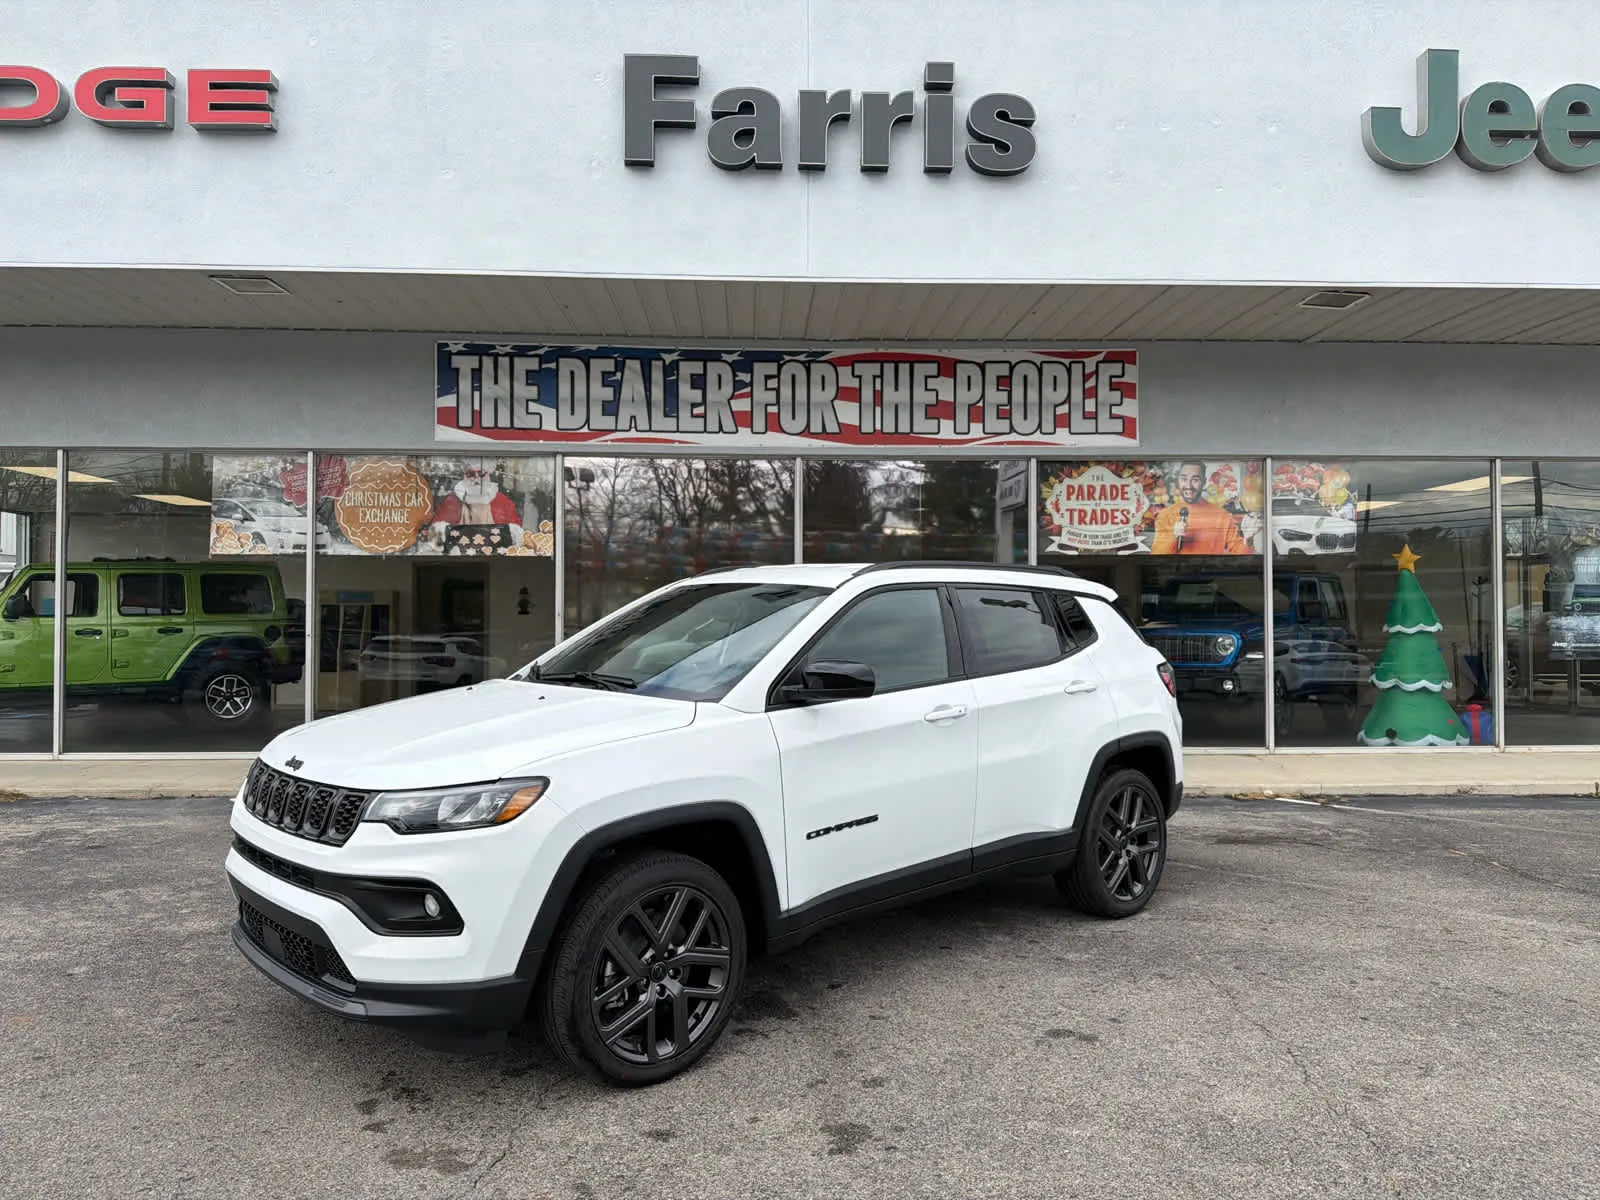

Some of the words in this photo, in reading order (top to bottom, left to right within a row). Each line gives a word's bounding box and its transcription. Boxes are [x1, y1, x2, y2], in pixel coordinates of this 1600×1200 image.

[624, 54, 1037, 177] Farris
[1361, 48, 1600, 173] Jee
[450, 354, 543, 430] THE
[556, 356, 739, 435] DEALER
[749, 359, 842, 436] FOR
[851, 360, 941, 435] THE
[953, 360, 1126, 436] PEOPLE
[345, 491, 401, 507] CHRISTMAS
[404, 491, 424, 507] CAR
[1066, 484, 1130, 501] PARADE
[359, 507, 409, 524] EXCHANGE
[1065, 508, 1131, 526] TRADES
